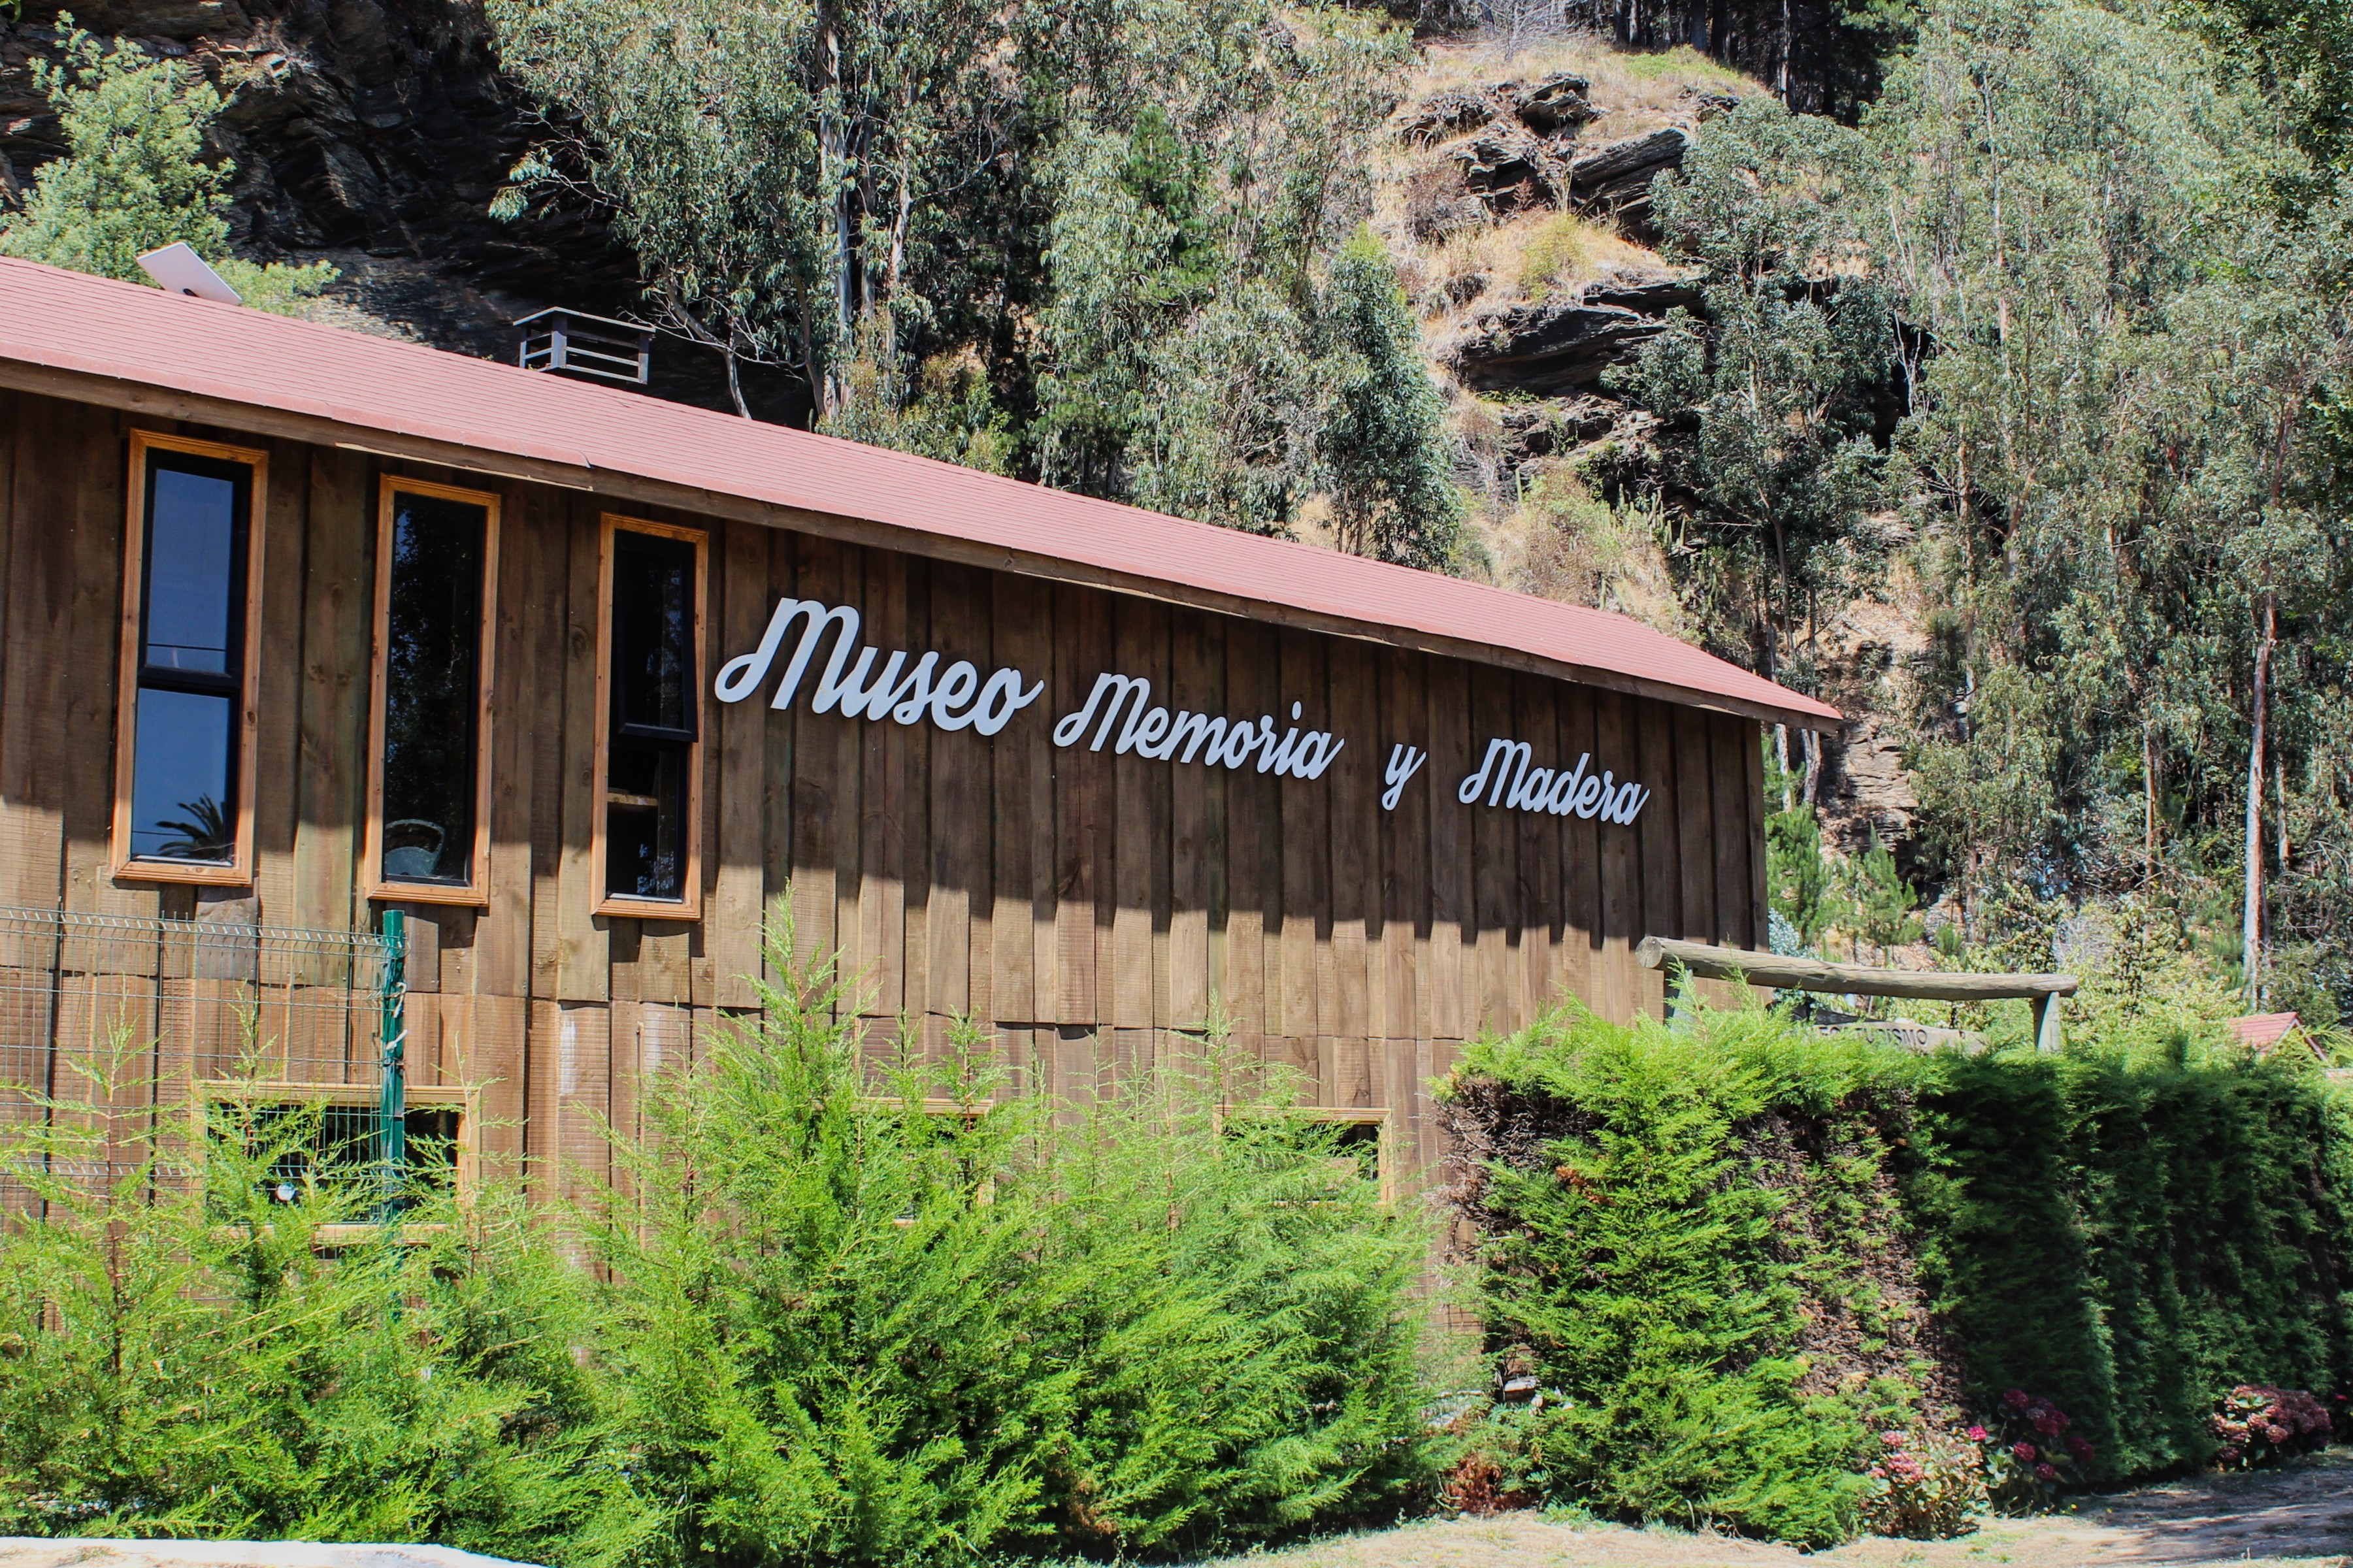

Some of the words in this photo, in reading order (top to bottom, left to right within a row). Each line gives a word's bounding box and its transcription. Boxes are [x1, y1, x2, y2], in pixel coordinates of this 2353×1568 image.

[714, 596, 1045, 737] Museo
[1052, 672, 1345, 781] Memoria
[1381, 743, 1427, 811] y
[1458, 738, 1651, 826] Madera
